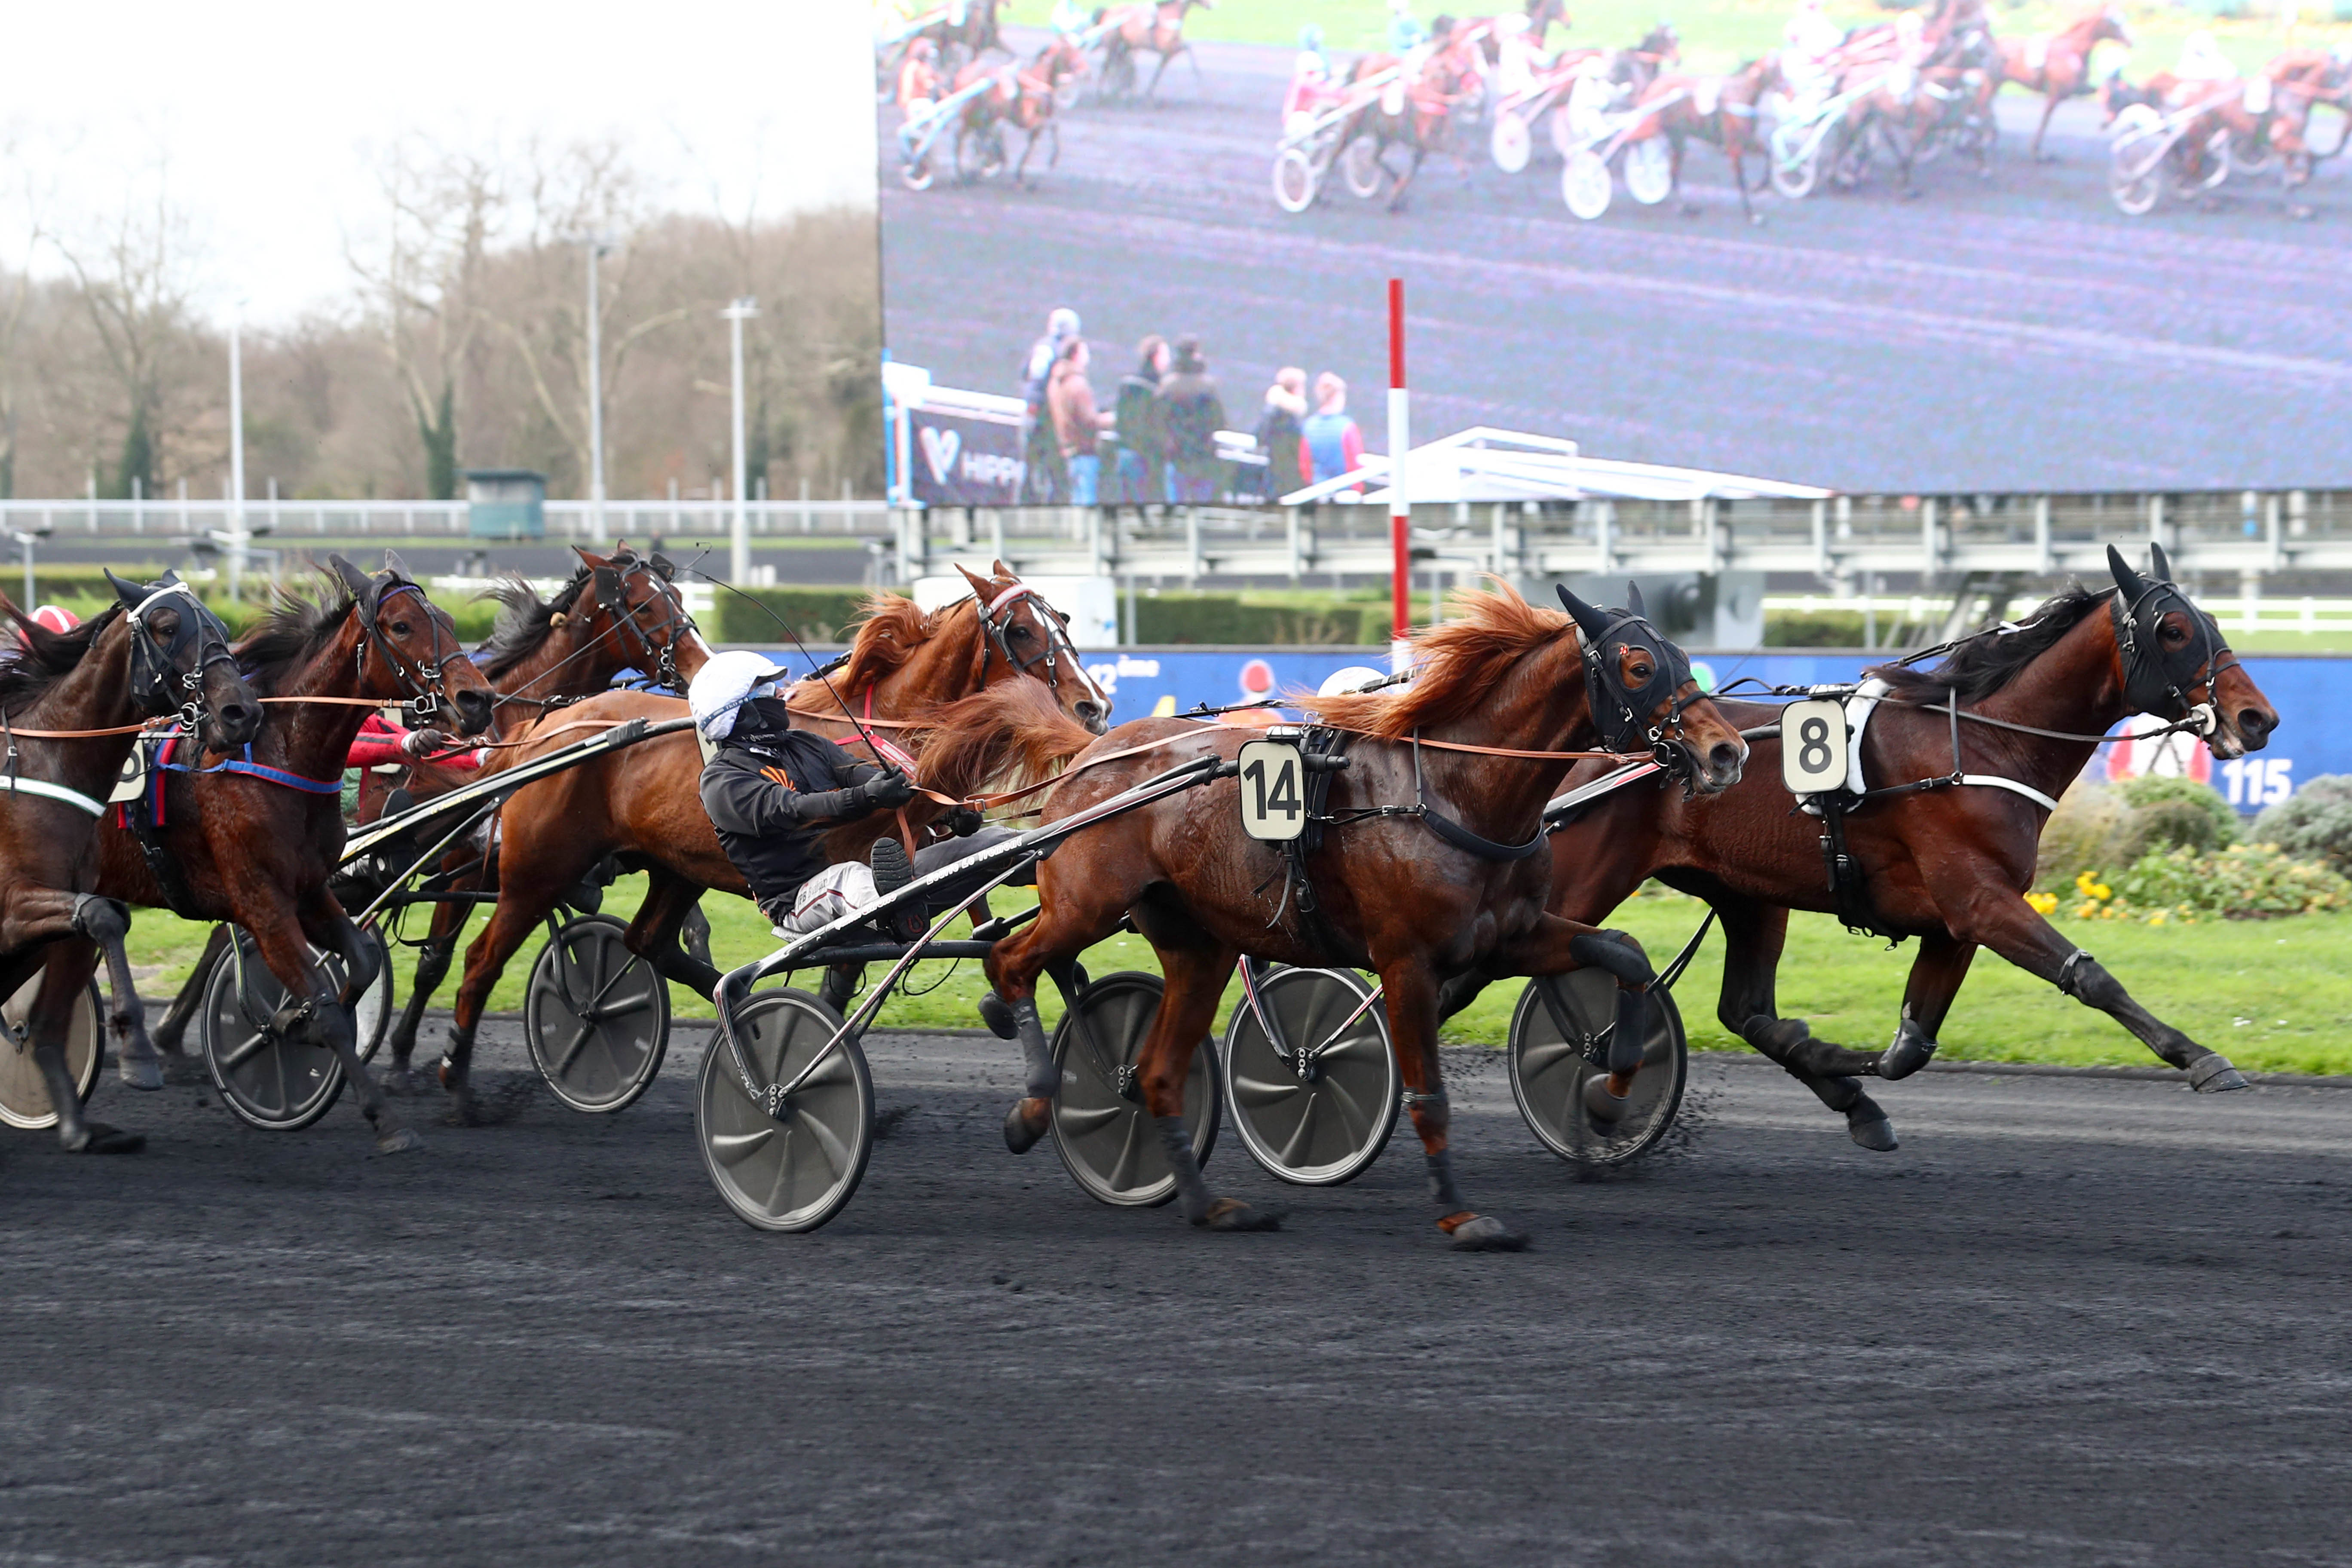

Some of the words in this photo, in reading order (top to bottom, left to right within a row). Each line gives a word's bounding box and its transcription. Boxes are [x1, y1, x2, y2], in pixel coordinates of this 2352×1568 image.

[1800, 717, 1832, 773] 8
[1243, 760, 1302, 820] 14
[2222, 759, 2292, 805] 115
